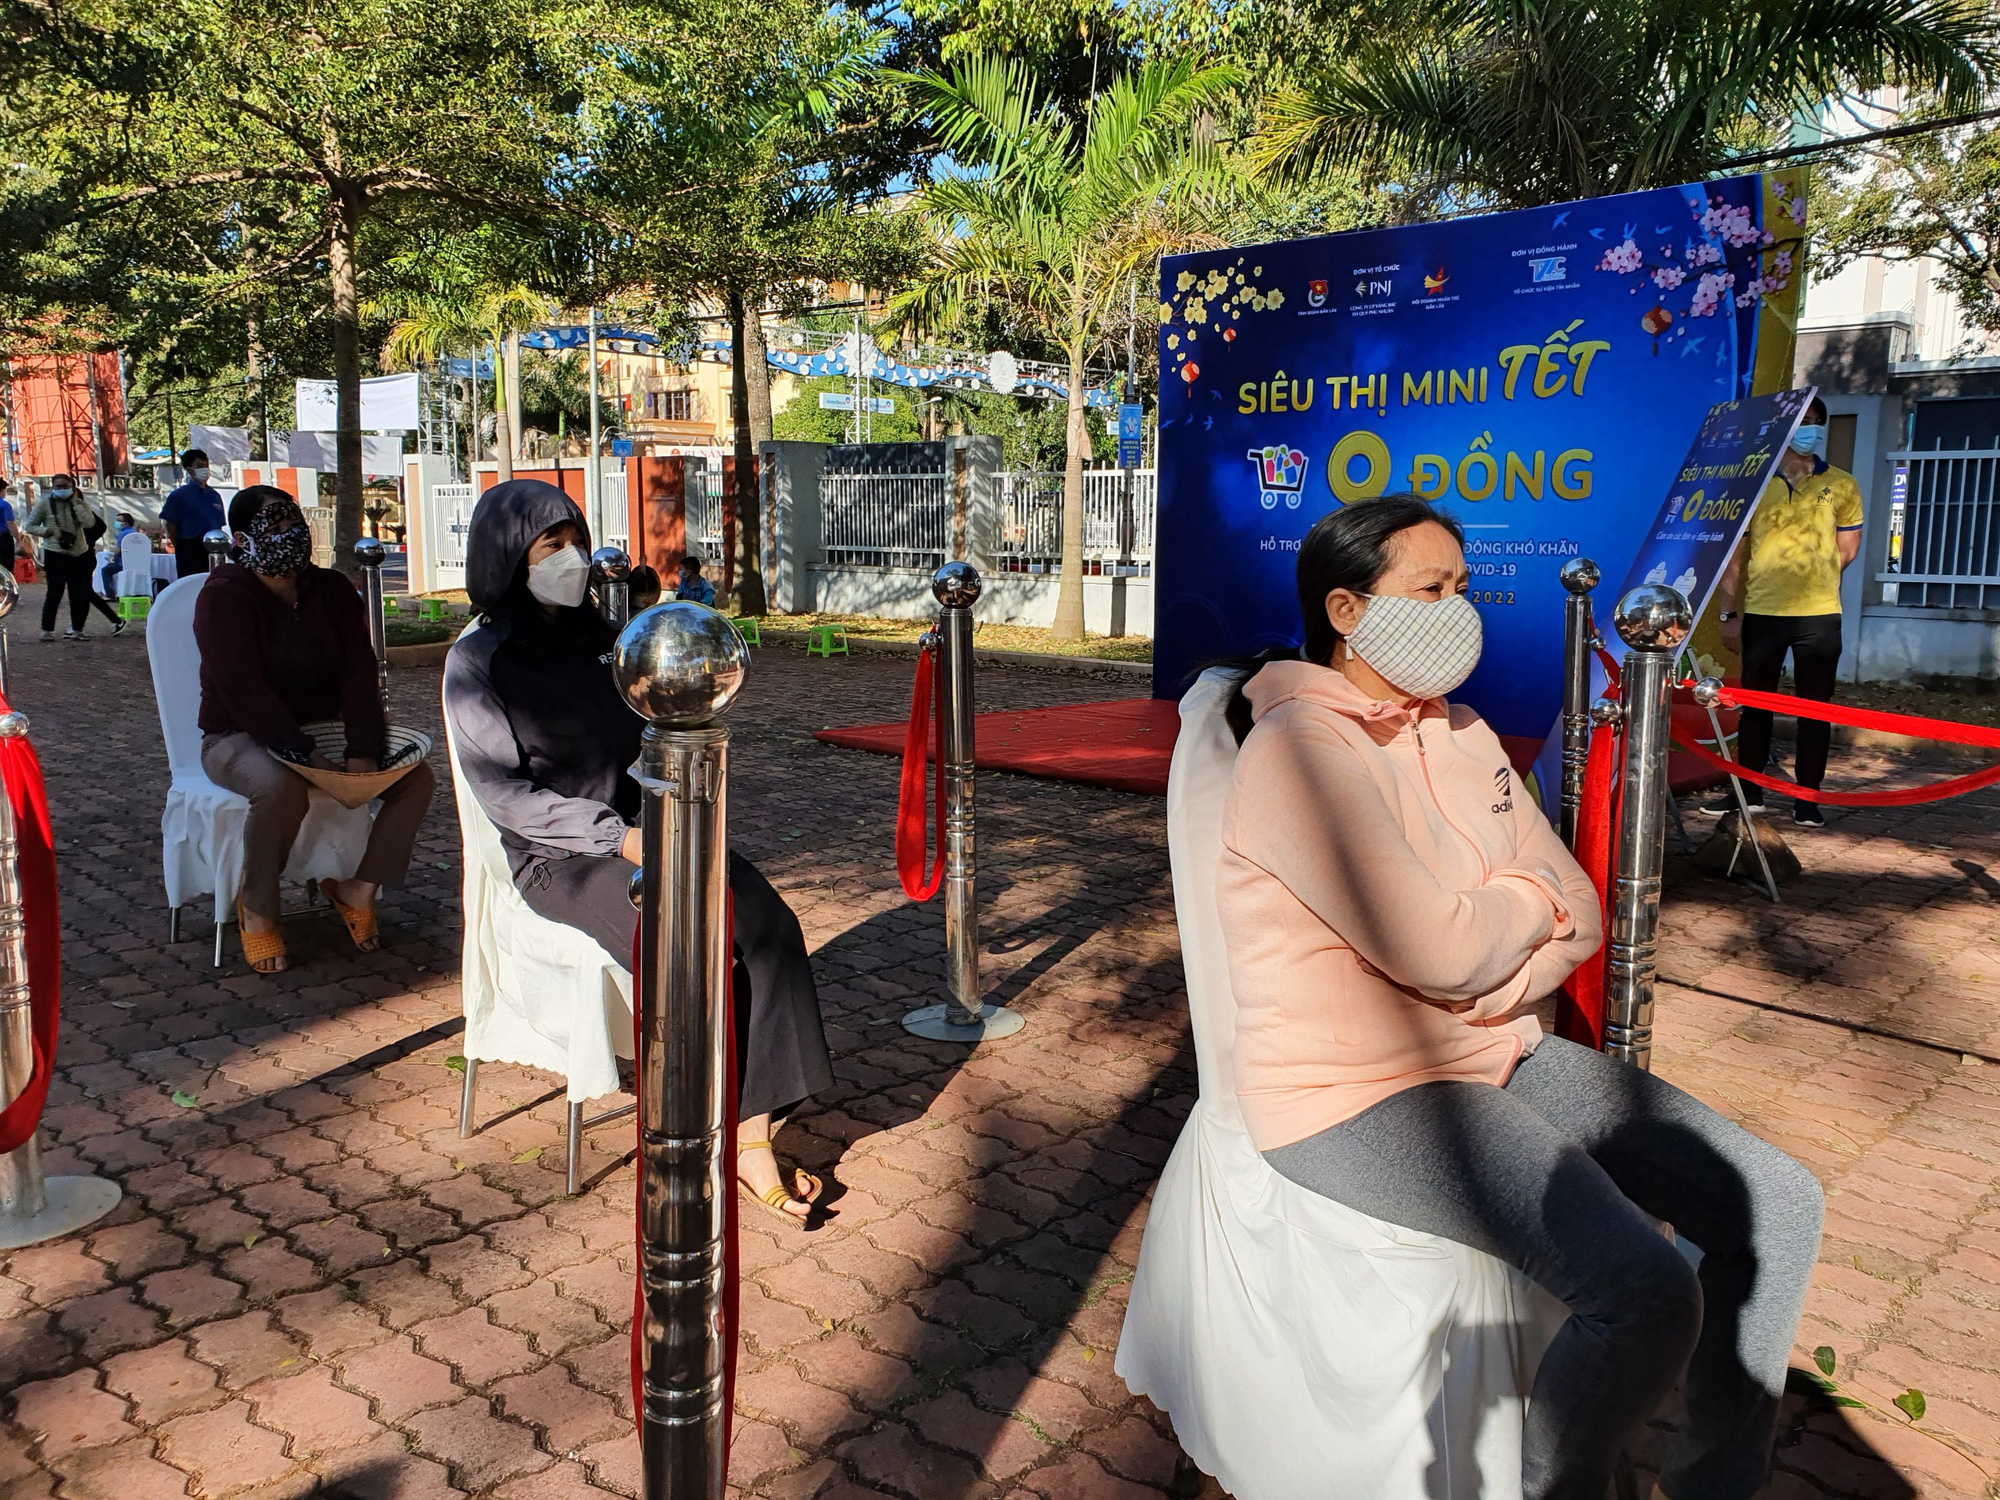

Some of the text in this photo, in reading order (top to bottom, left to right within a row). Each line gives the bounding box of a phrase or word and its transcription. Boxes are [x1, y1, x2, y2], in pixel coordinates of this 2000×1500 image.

[1369, 279, 1392, 297] PNJ
[1238, 318, 1611, 417] SIÊU THỊ MINI TẾT
[1408, 430, 1593, 501] ĐỒNG
[1260, 535, 1578, 557] HỖ TRỢ ĐỘNG KHÓ KHĂN
[1464, 563, 1517, 576] OVID-19
[1473, 591, 1515, 604] 2022
[1491, 799, 1513, 814] adi
